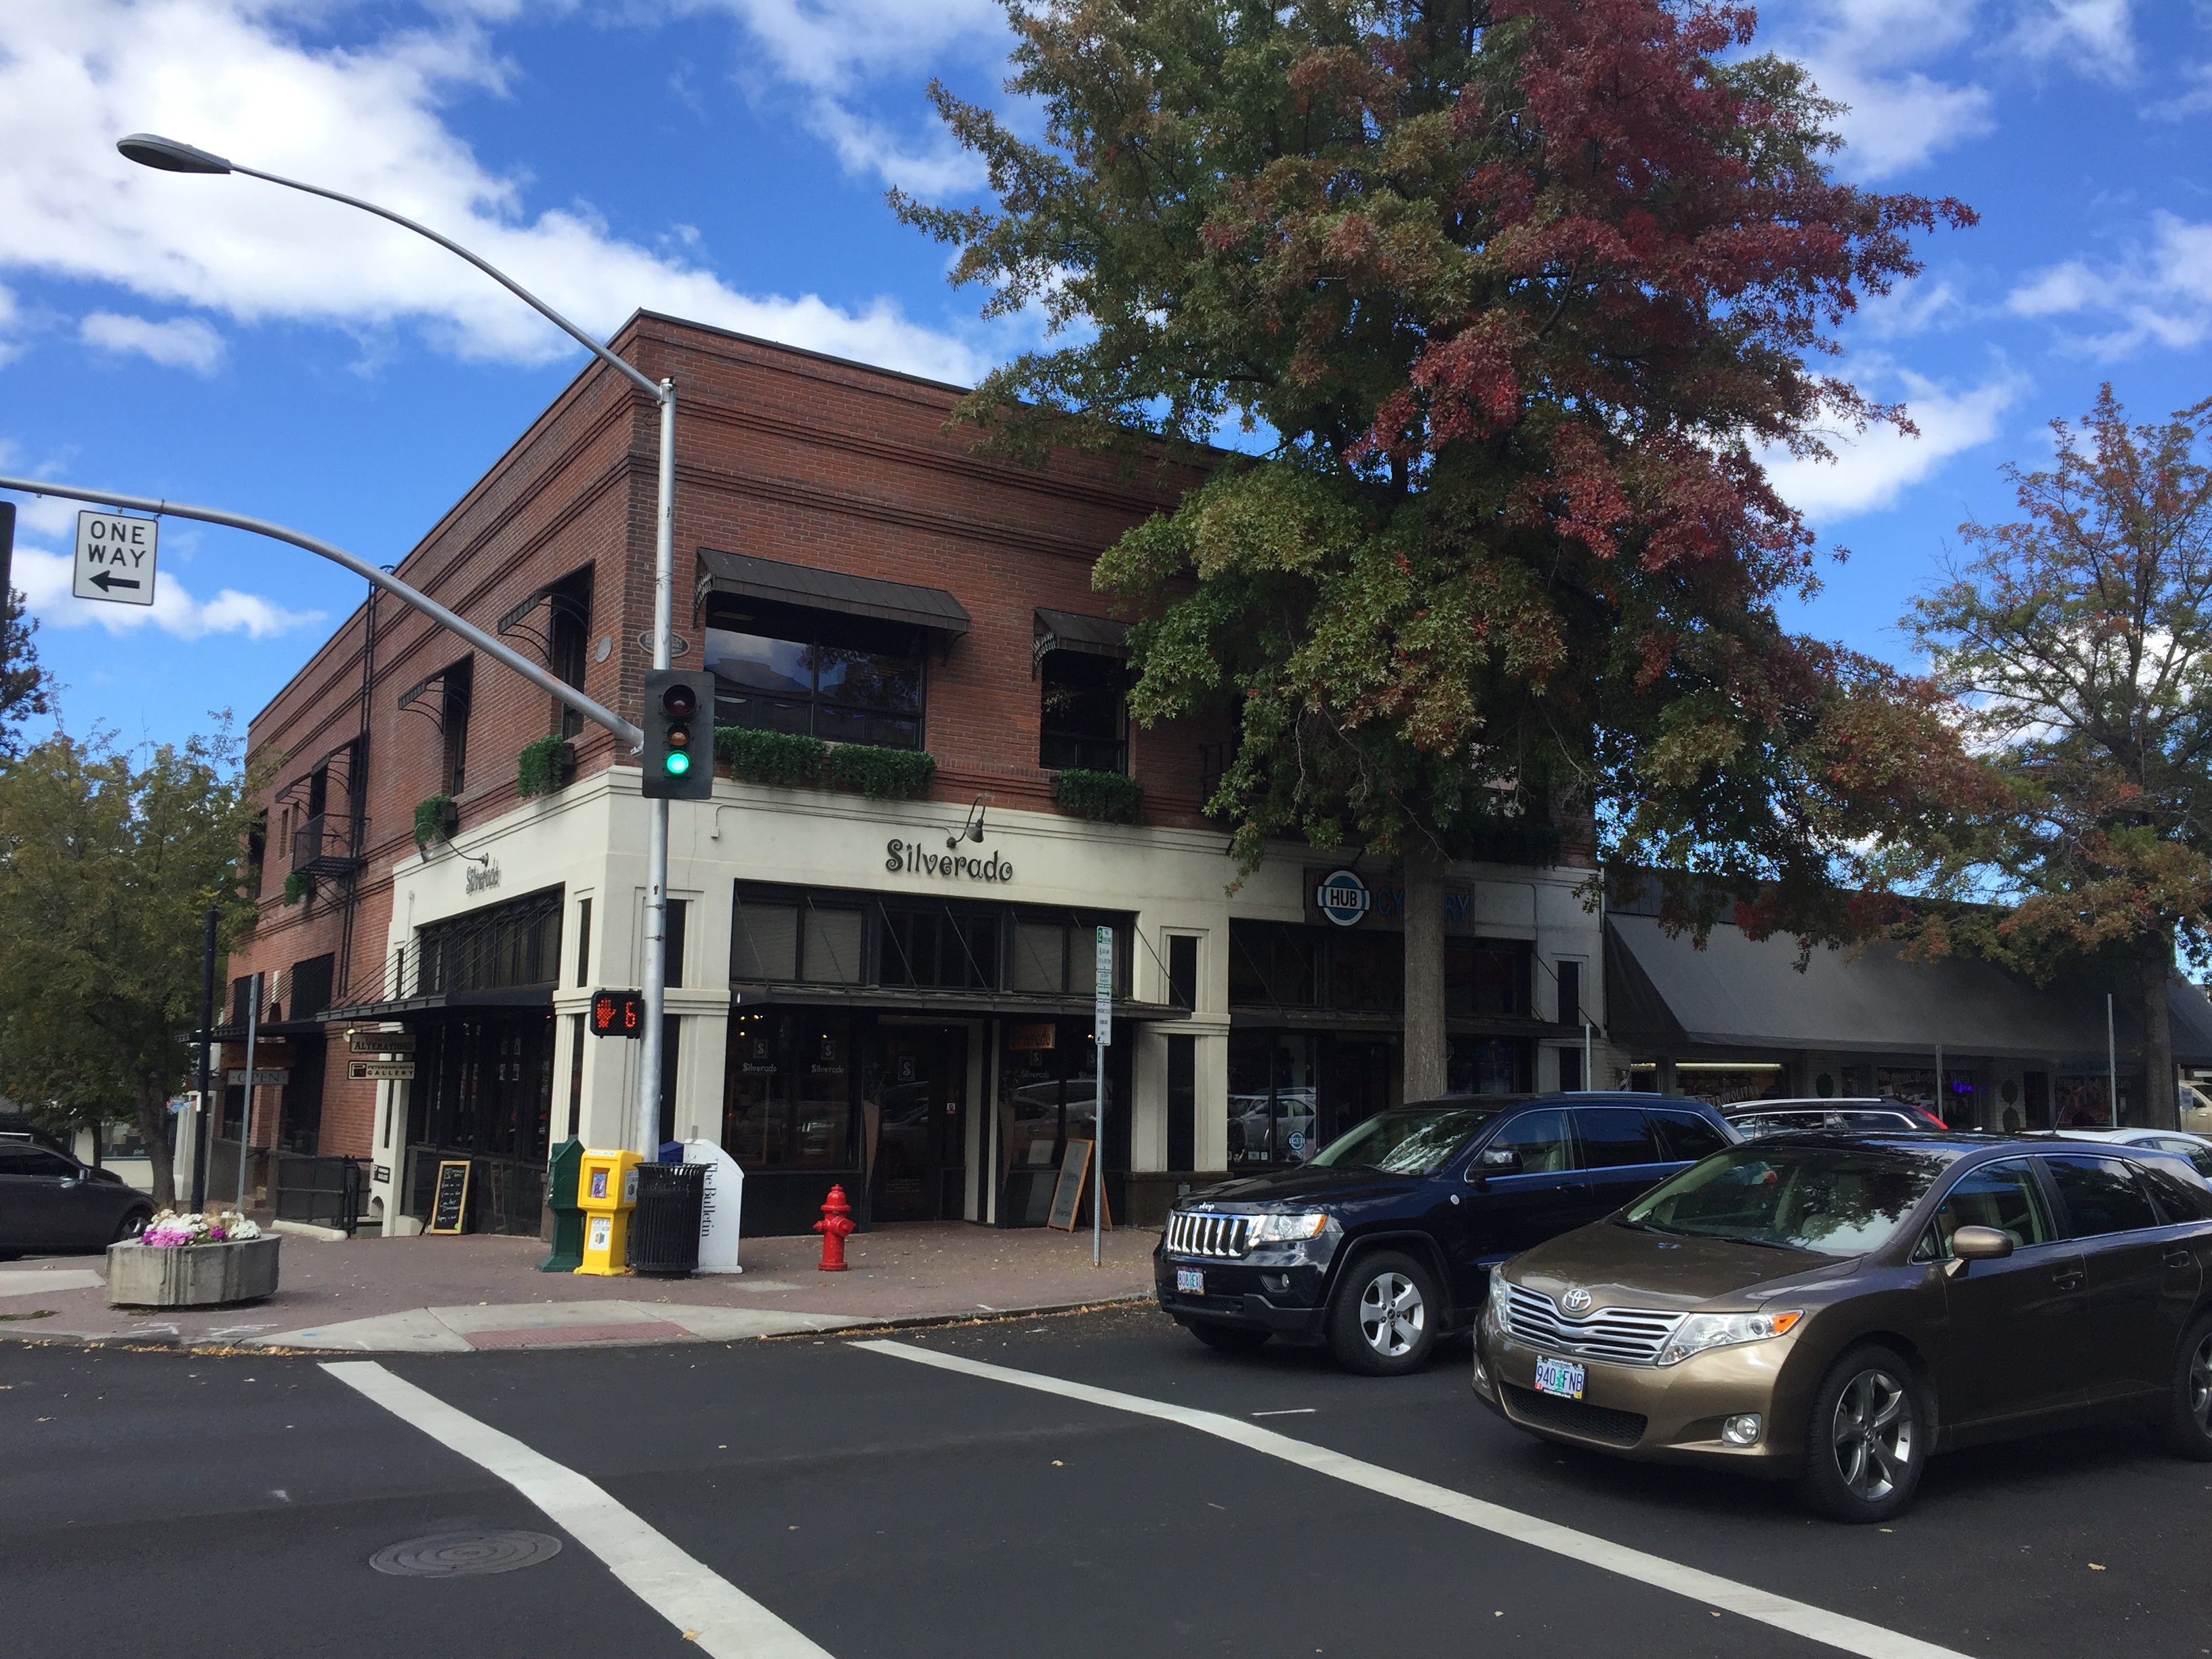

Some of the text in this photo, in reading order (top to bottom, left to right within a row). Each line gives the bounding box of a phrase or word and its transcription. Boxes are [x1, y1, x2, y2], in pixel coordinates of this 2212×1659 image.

[90, 520, 145, 545] ONE
[88, 543, 146, 568] WAY
[885, 838, 1013, 881] Silverado
[1330, 888, 1357, 907] HUB
[626, 1002, 636, 1028] 6
[354, 1042, 413, 1050] ALTERATIONS
[237, 1072, 280, 1083] OPEN
[743, 1062, 777, 1072] Silverado
[811, 1064, 845, 1073] Silverado
[701, 1158, 718, 1237] The Bulletin
[1536, 1365, 1583, 1392] 940 FNB
